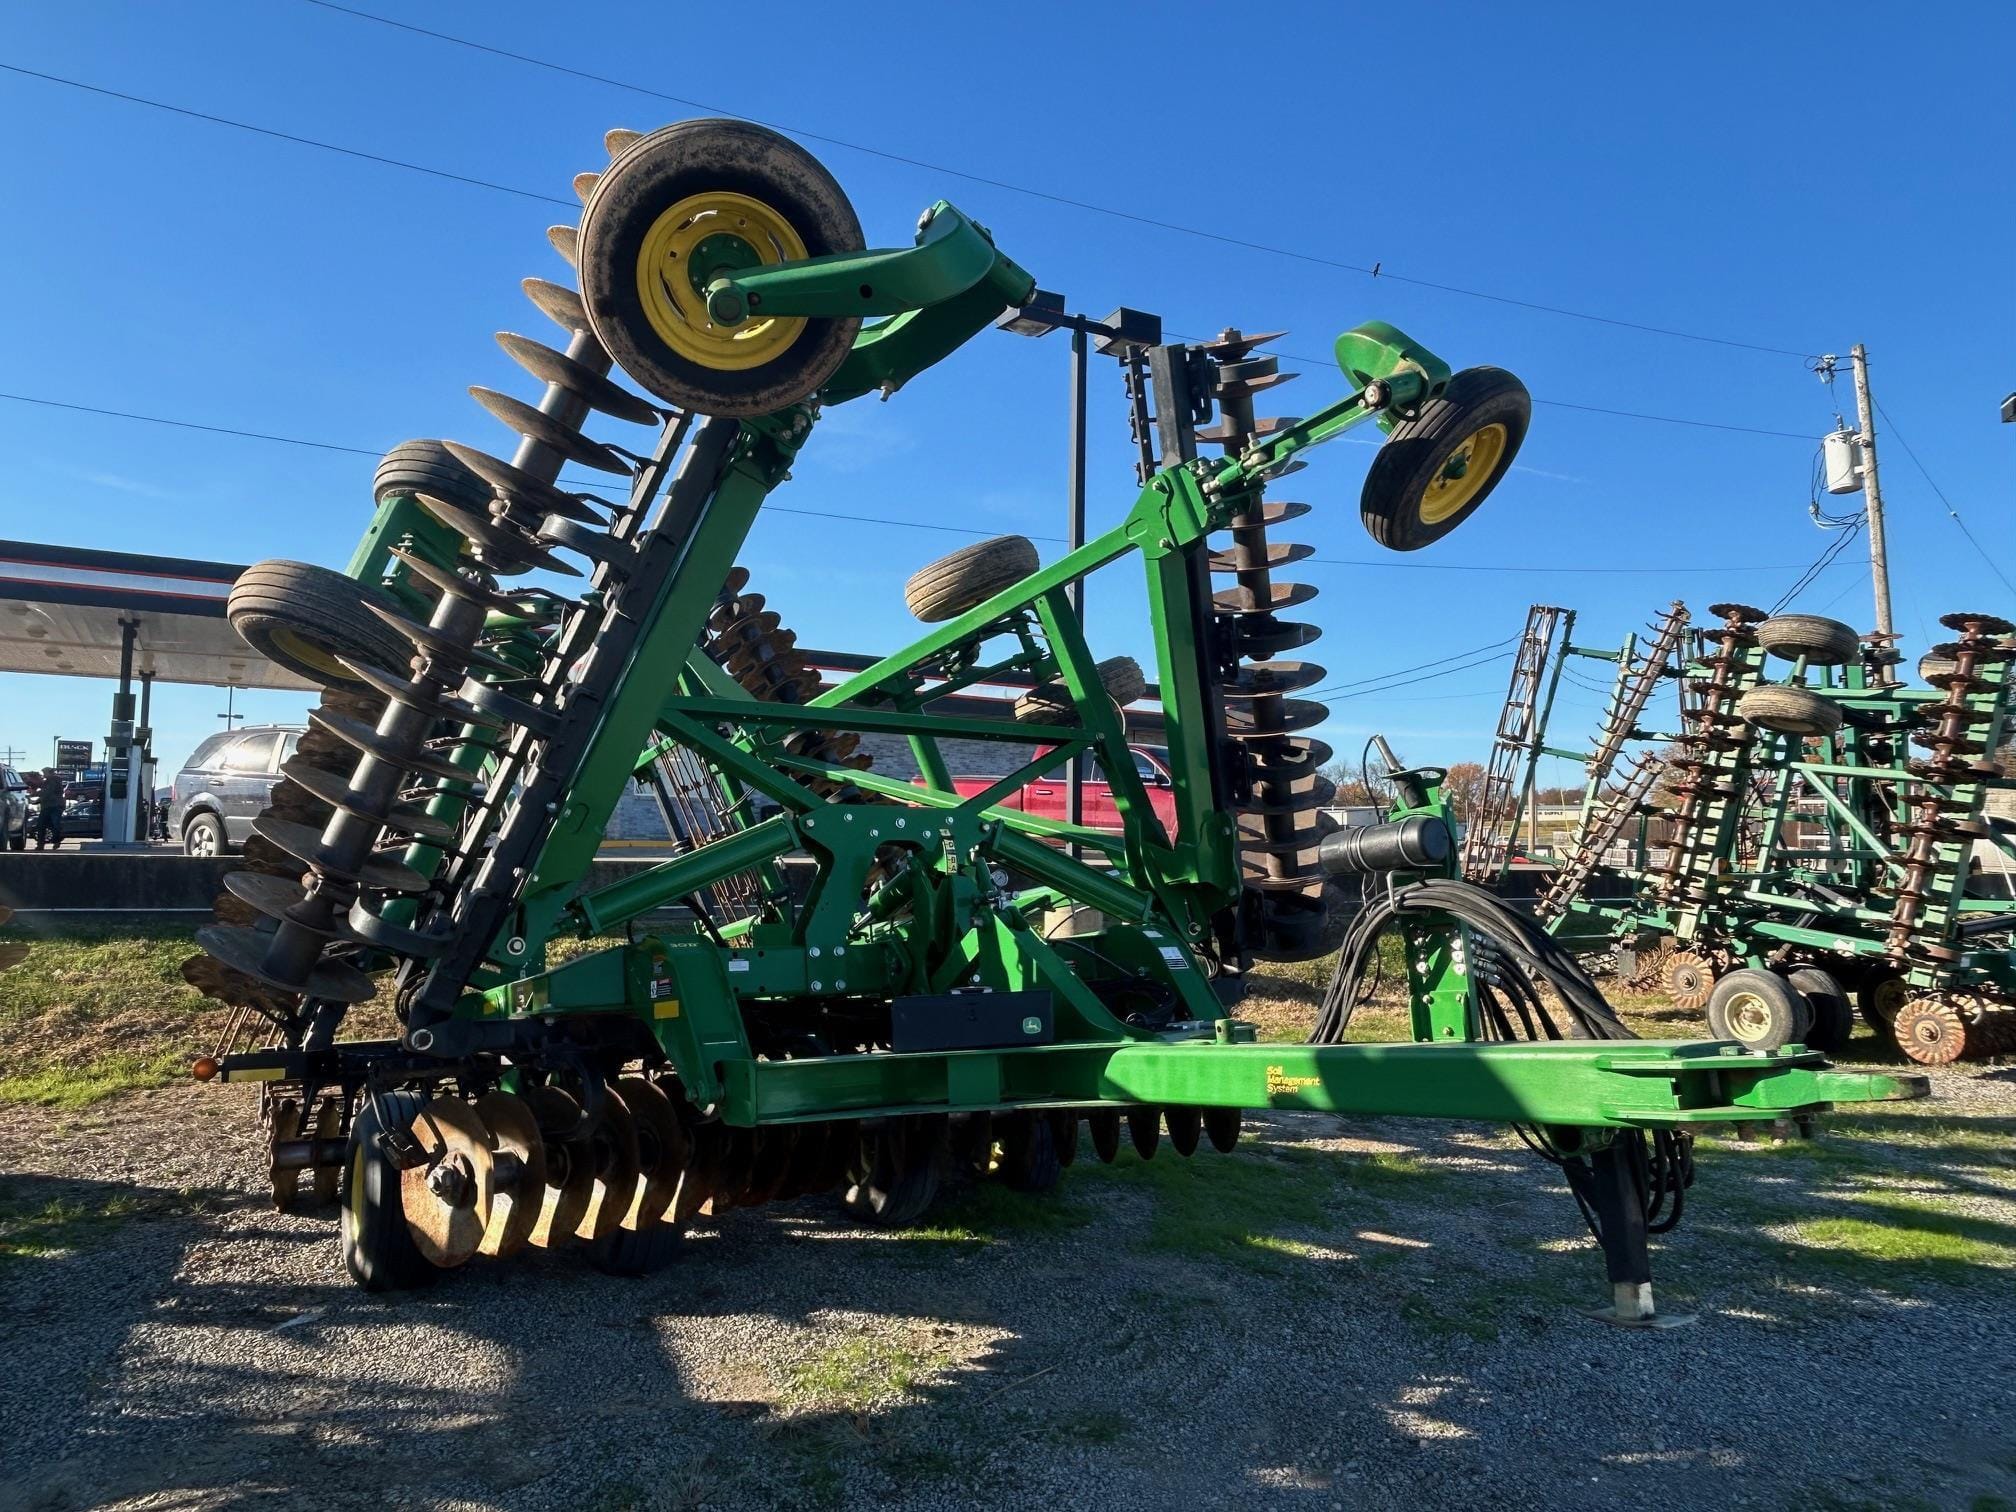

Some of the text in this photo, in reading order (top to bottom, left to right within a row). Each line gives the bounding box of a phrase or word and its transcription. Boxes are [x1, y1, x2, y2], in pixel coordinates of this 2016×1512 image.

[1266, 1066, 1282, 1075] Soil
[1267, 1075, 1320, 1087] Management
[1267, 1084, 1298, 1094] System
